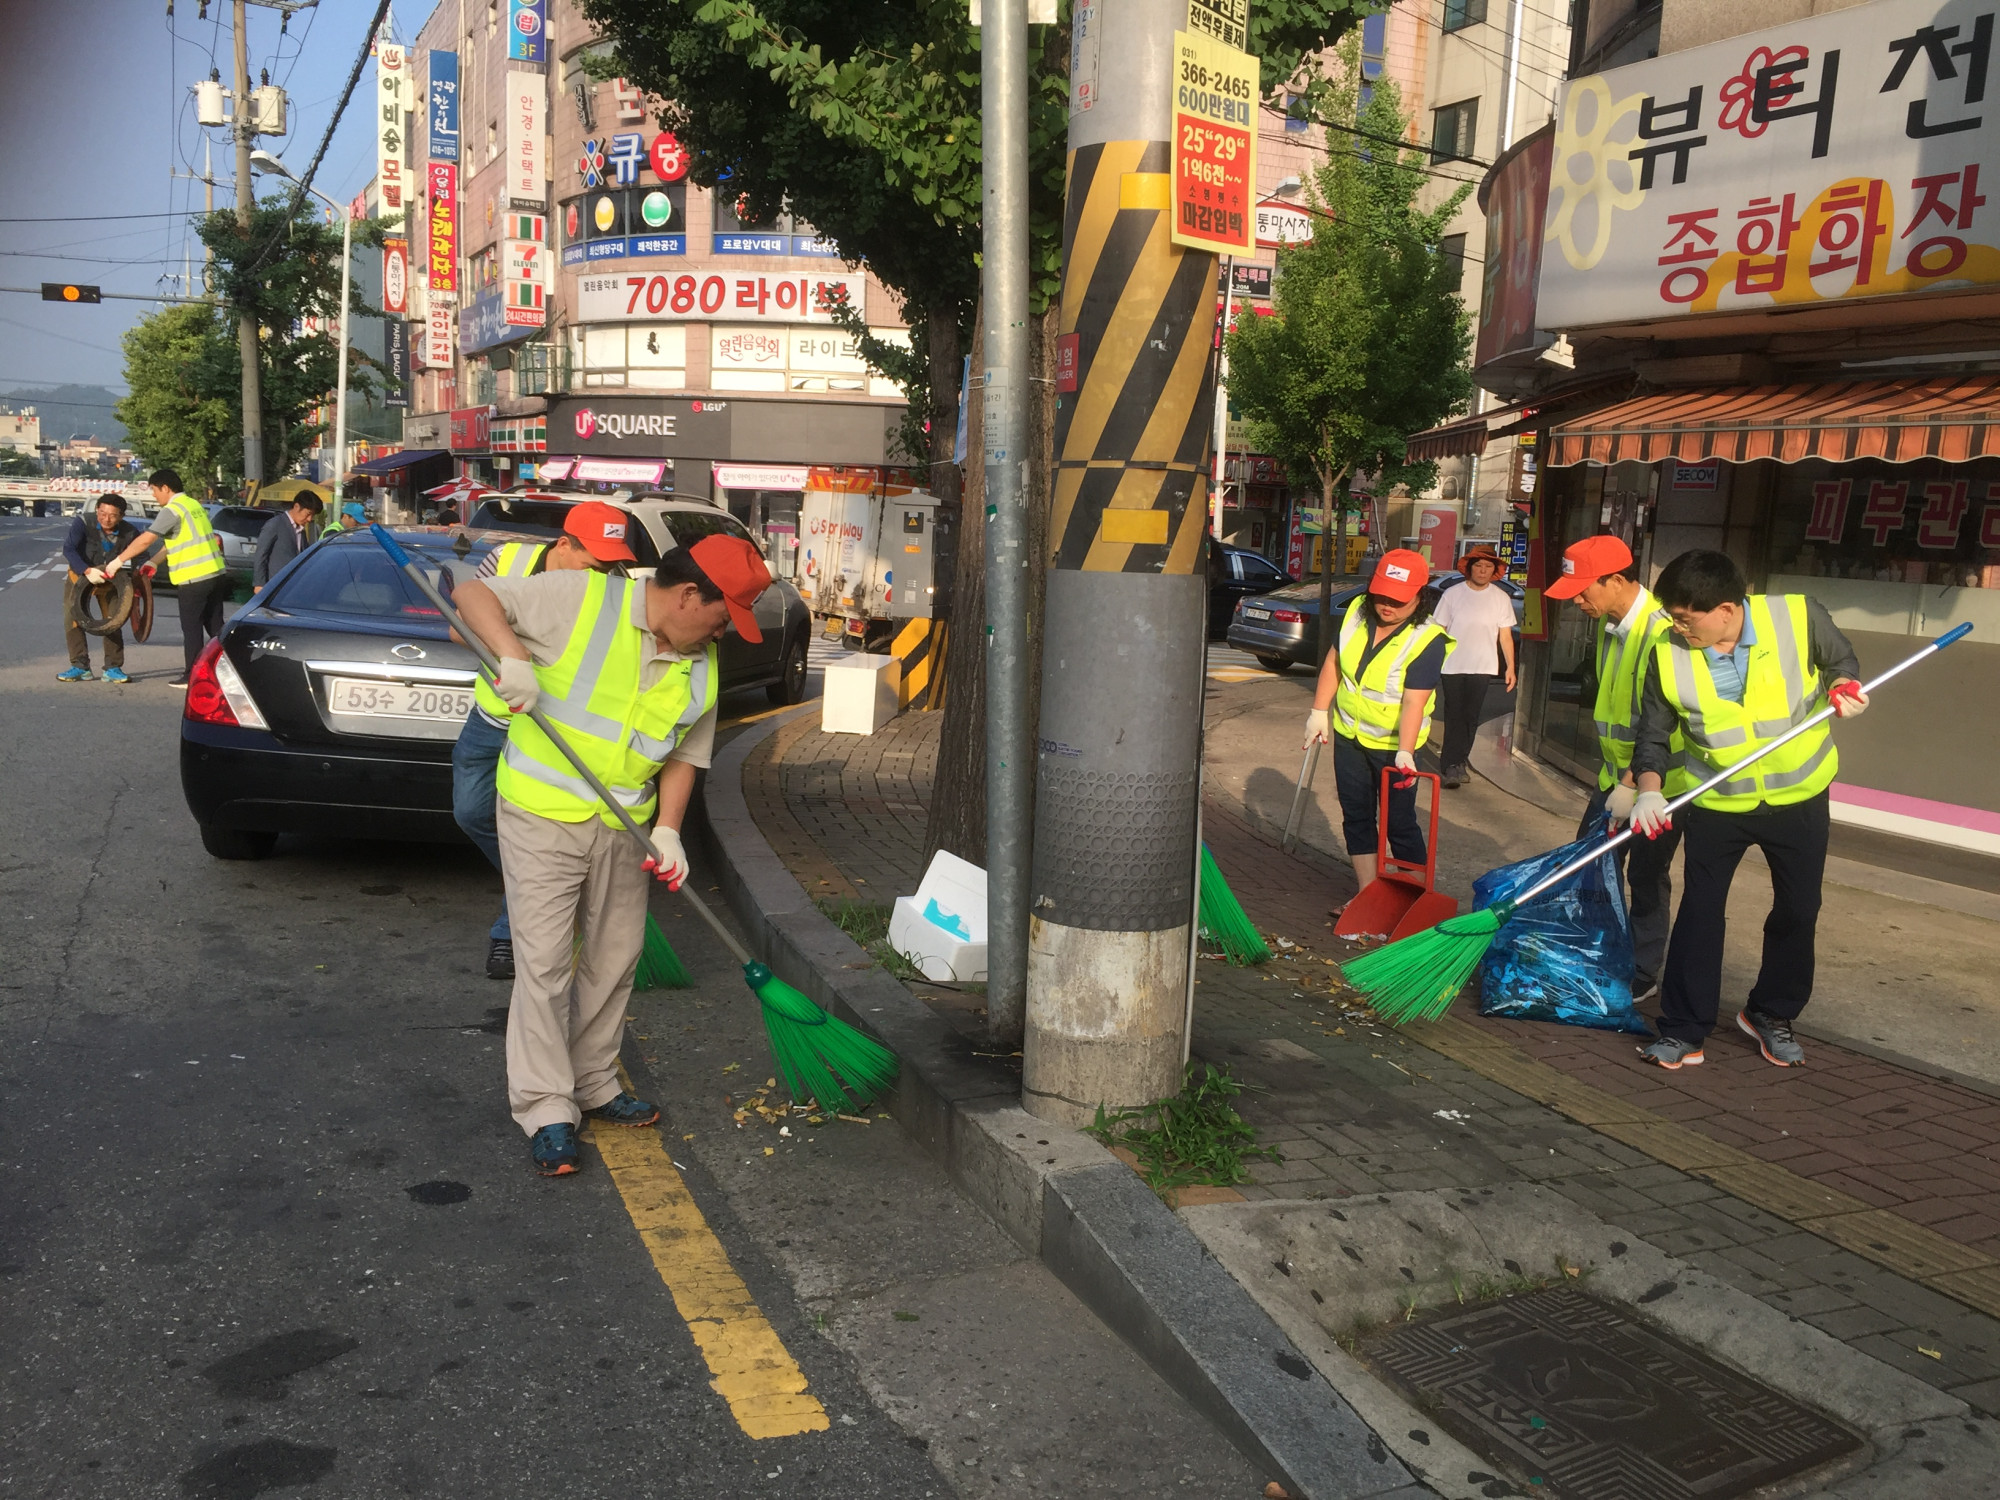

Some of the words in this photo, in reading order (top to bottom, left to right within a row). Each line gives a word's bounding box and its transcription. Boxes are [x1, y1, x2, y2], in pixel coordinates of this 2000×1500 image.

[1190, 4, 1245, 50] 전액후불제
[519, 42, 537, 57] 3F
[1181, 46, 1197, 60] 031)
[1181, 60, 1250, 99] 366-2465
[382, 160, 401, 208] 모텔
[1182, 201, 1243, 238] 마감임박
[722, 239, 781, 251] 프로암V대대
[626, 275, 726, 314] 7080
[392, 323, 401, 348] PARIS
[431, 310, 450, 363] 라이브카페
[720, 333, 780, 359] 열린음악회
[800, 339, 858, 358] 라이브
[597, 413, 677, 440] SQUARE
[1676, 468, 1716, 481] SECOM
[874, 583, 887, 594] CJ
[347, 686, 396, 710] 53수
[407, 690, 470, 716] 2085
